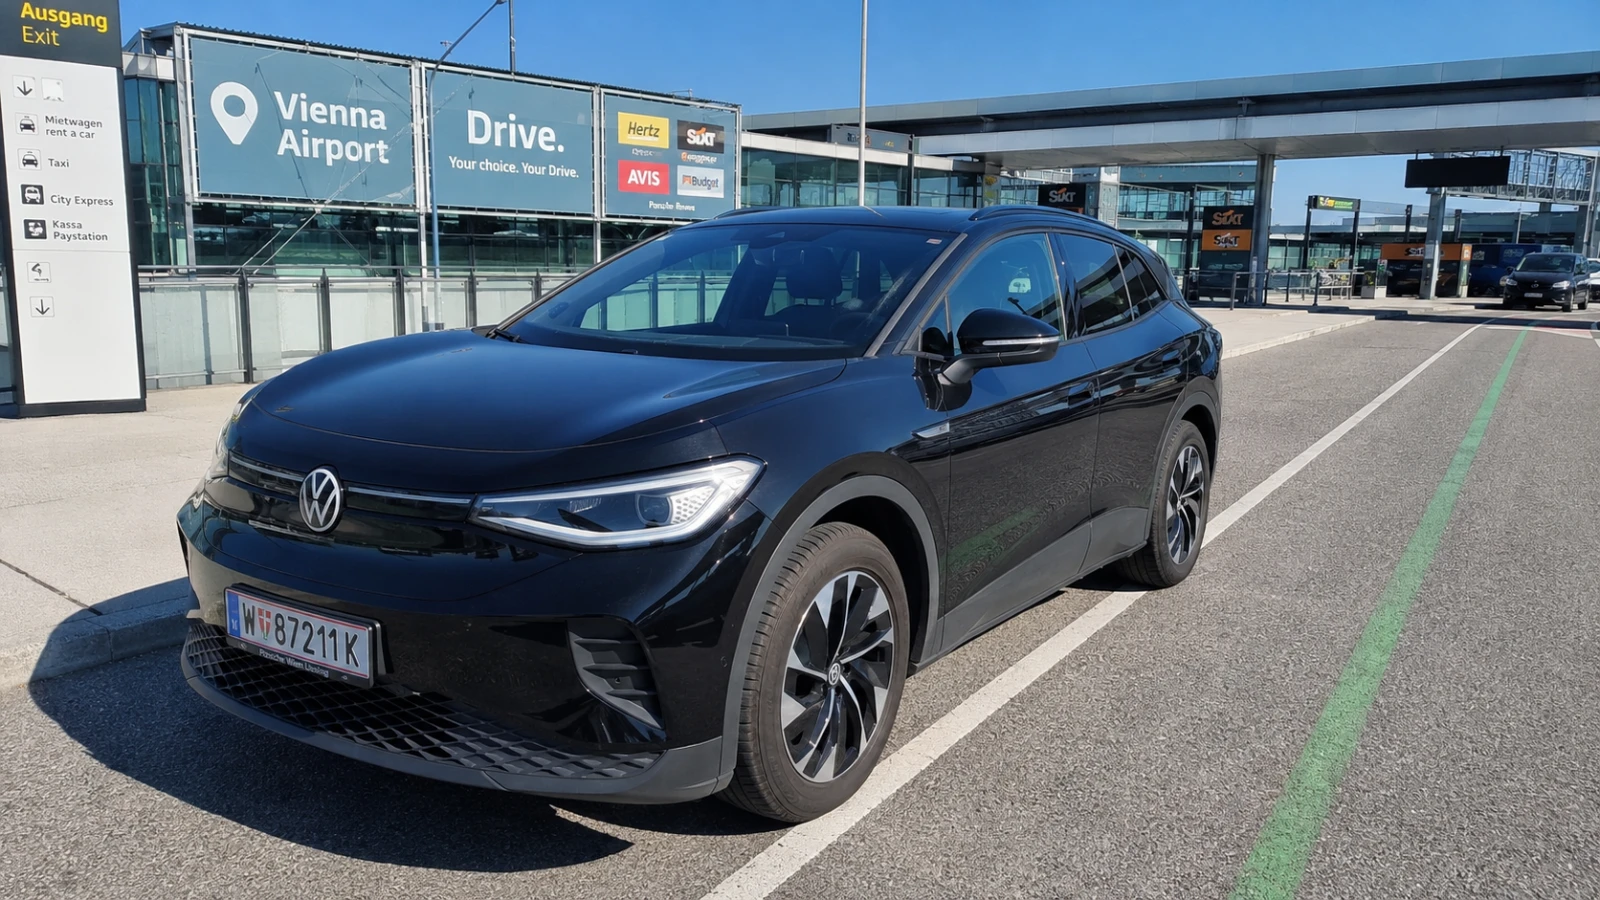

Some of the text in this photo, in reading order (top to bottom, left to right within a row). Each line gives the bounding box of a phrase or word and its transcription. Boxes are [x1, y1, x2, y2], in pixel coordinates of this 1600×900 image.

[20, 2, 108, 33] Ausgang
[22, 26, 60, 46] Exit
[273, 91, 388, 131] Vienna
[45, 115, 103, 129] Mietwagen
[627, 121, 661, 138] Hertz
[45, 128, 96, 139] rent a car
[467, 109, 565, 153] Drive.
[686, 127, 717, 147] SIXT
[276, 129, 390, 167] Airport
[48, 158, 70, 168] Taxi
[448, 156, 580, 178] Your choice. Your Drive.
[627, 169, 660, 186] AVIS
[692, 176, 719, 190] Budget
[50, 194, 114, 207] City Express
[1048, 188, 1076, 203] SIXT
[52, 220, 83, 230] Kassa
[53, 232, 108, 242] Paystation
[242, 602, 255, 636] W
